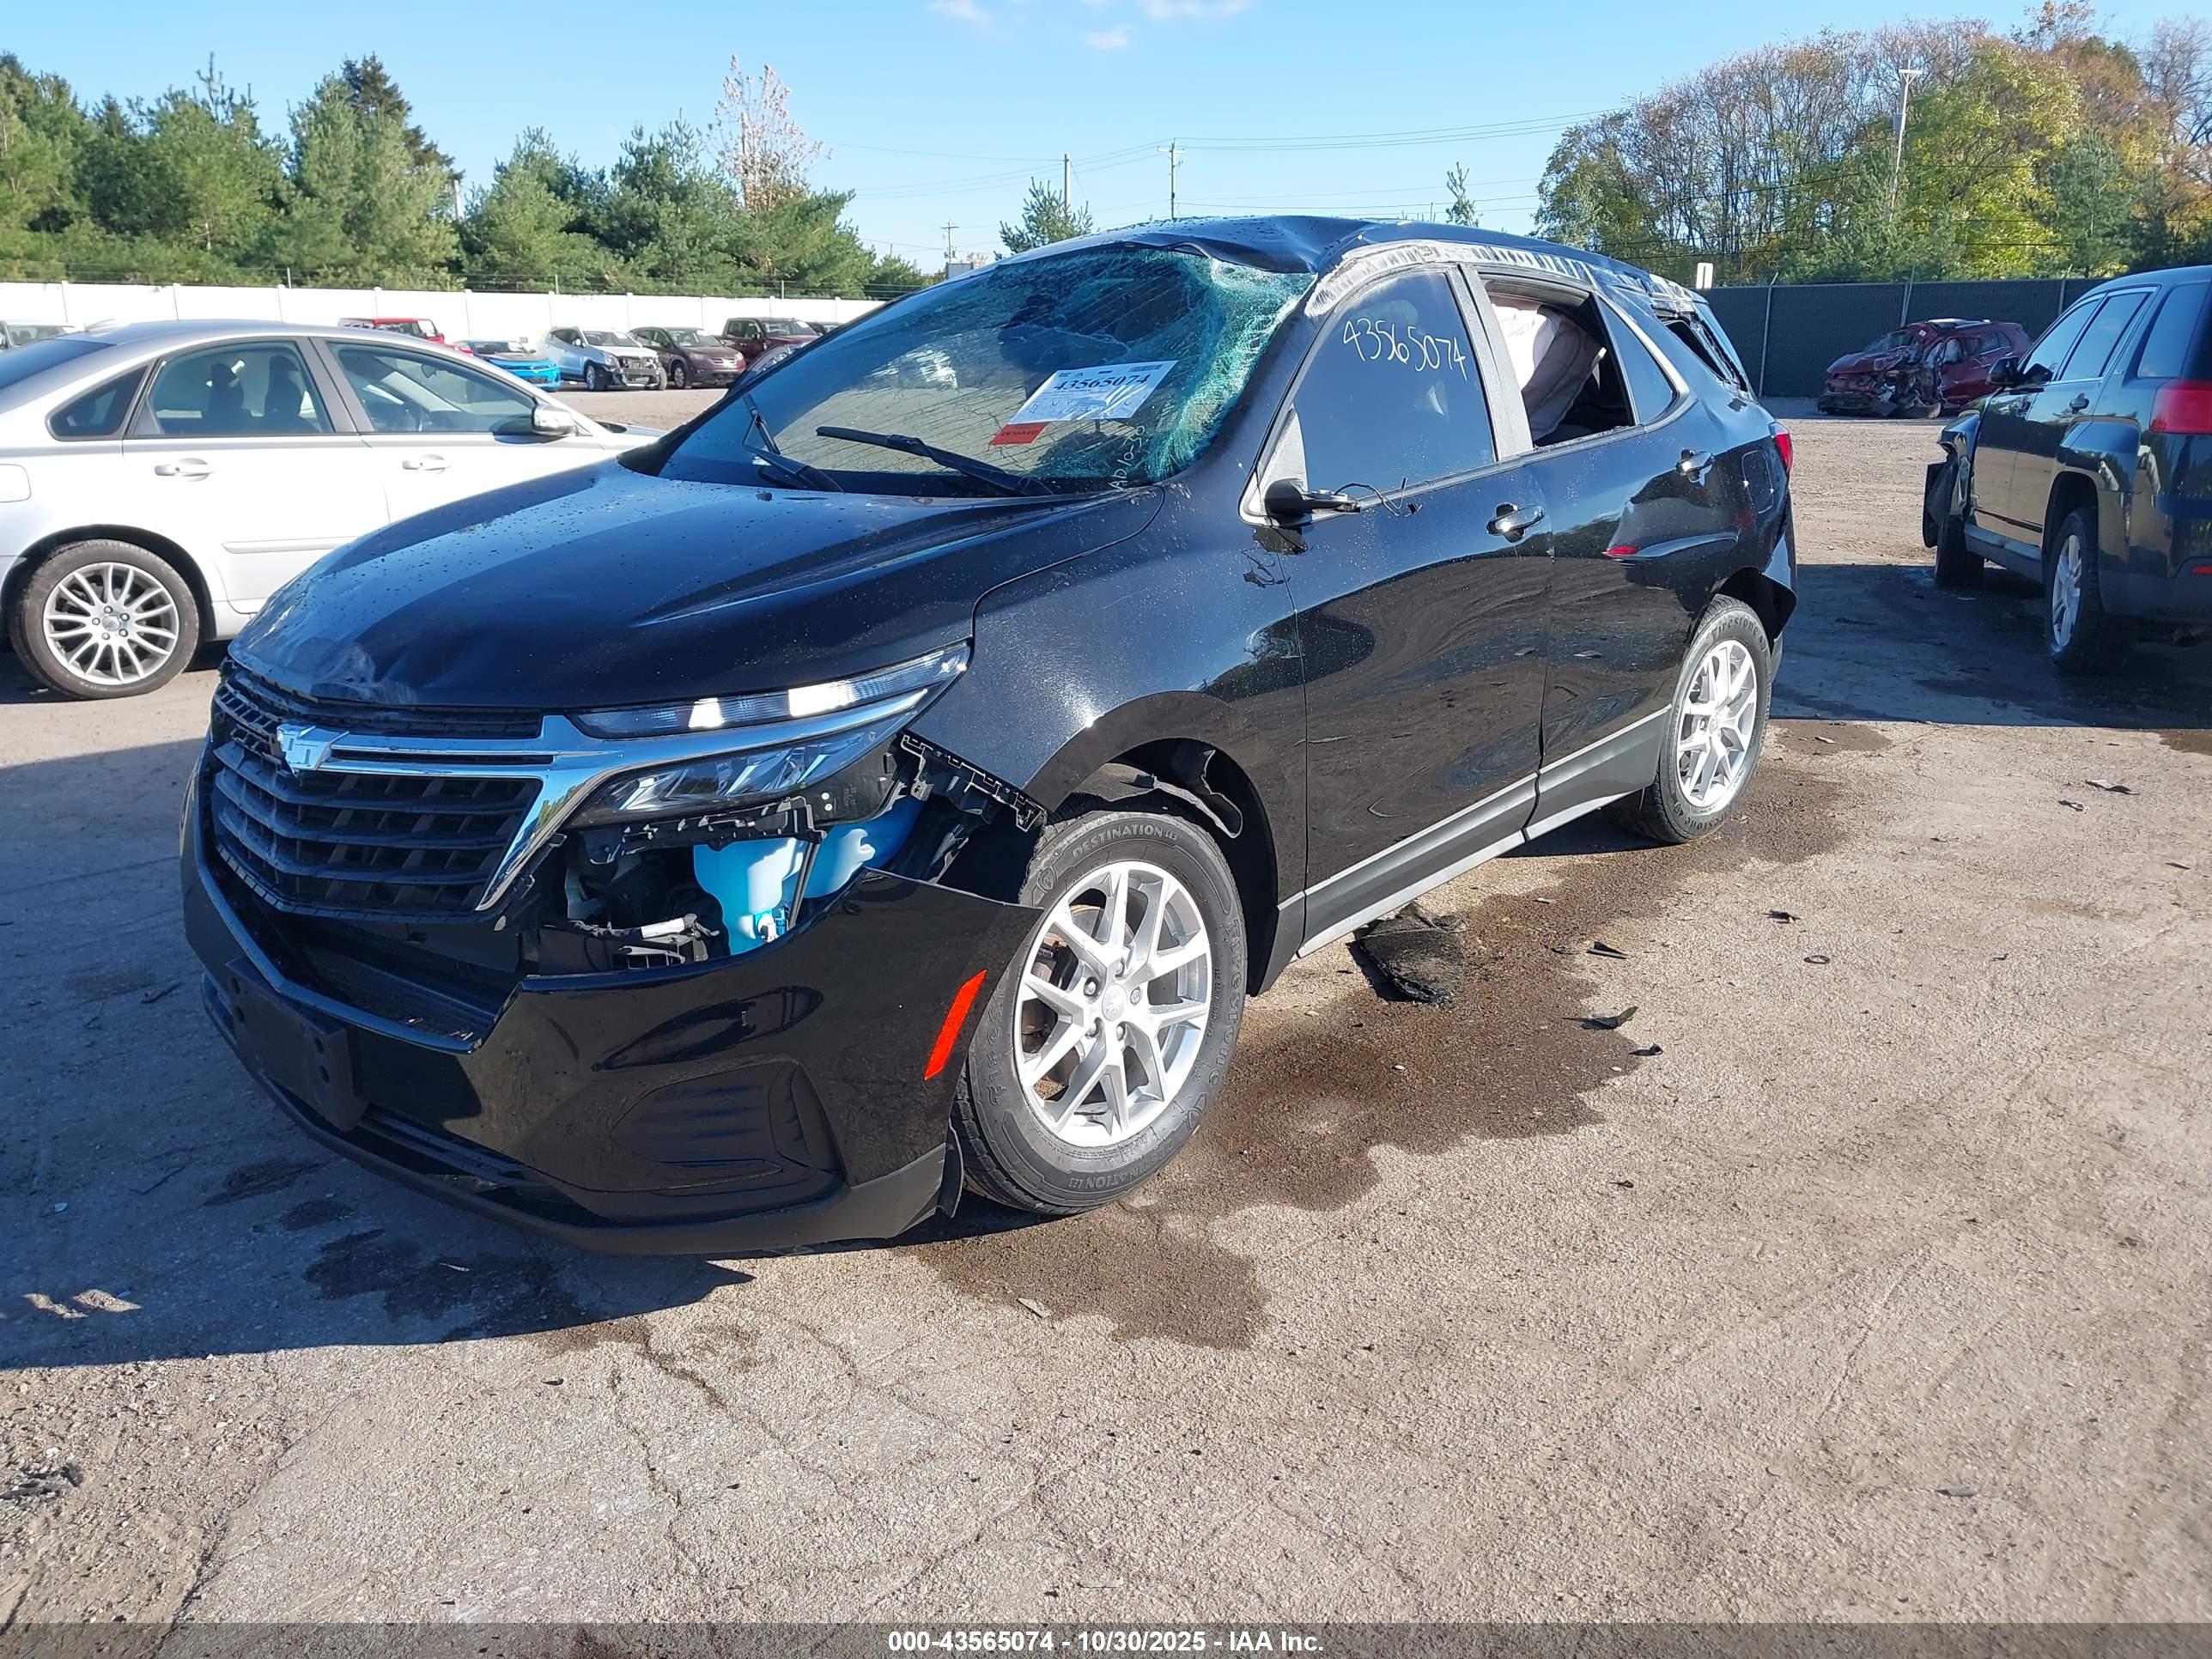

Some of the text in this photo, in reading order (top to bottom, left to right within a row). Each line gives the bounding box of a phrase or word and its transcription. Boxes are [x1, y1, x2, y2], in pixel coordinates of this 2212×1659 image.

[1343, 318, 1468, 381] 43565074
[1054, 374, 1152, 390] 43565074
[1072, 823, 1164, 859] DESTINATION
[1208, 920, 1243, 1085] Firestone
